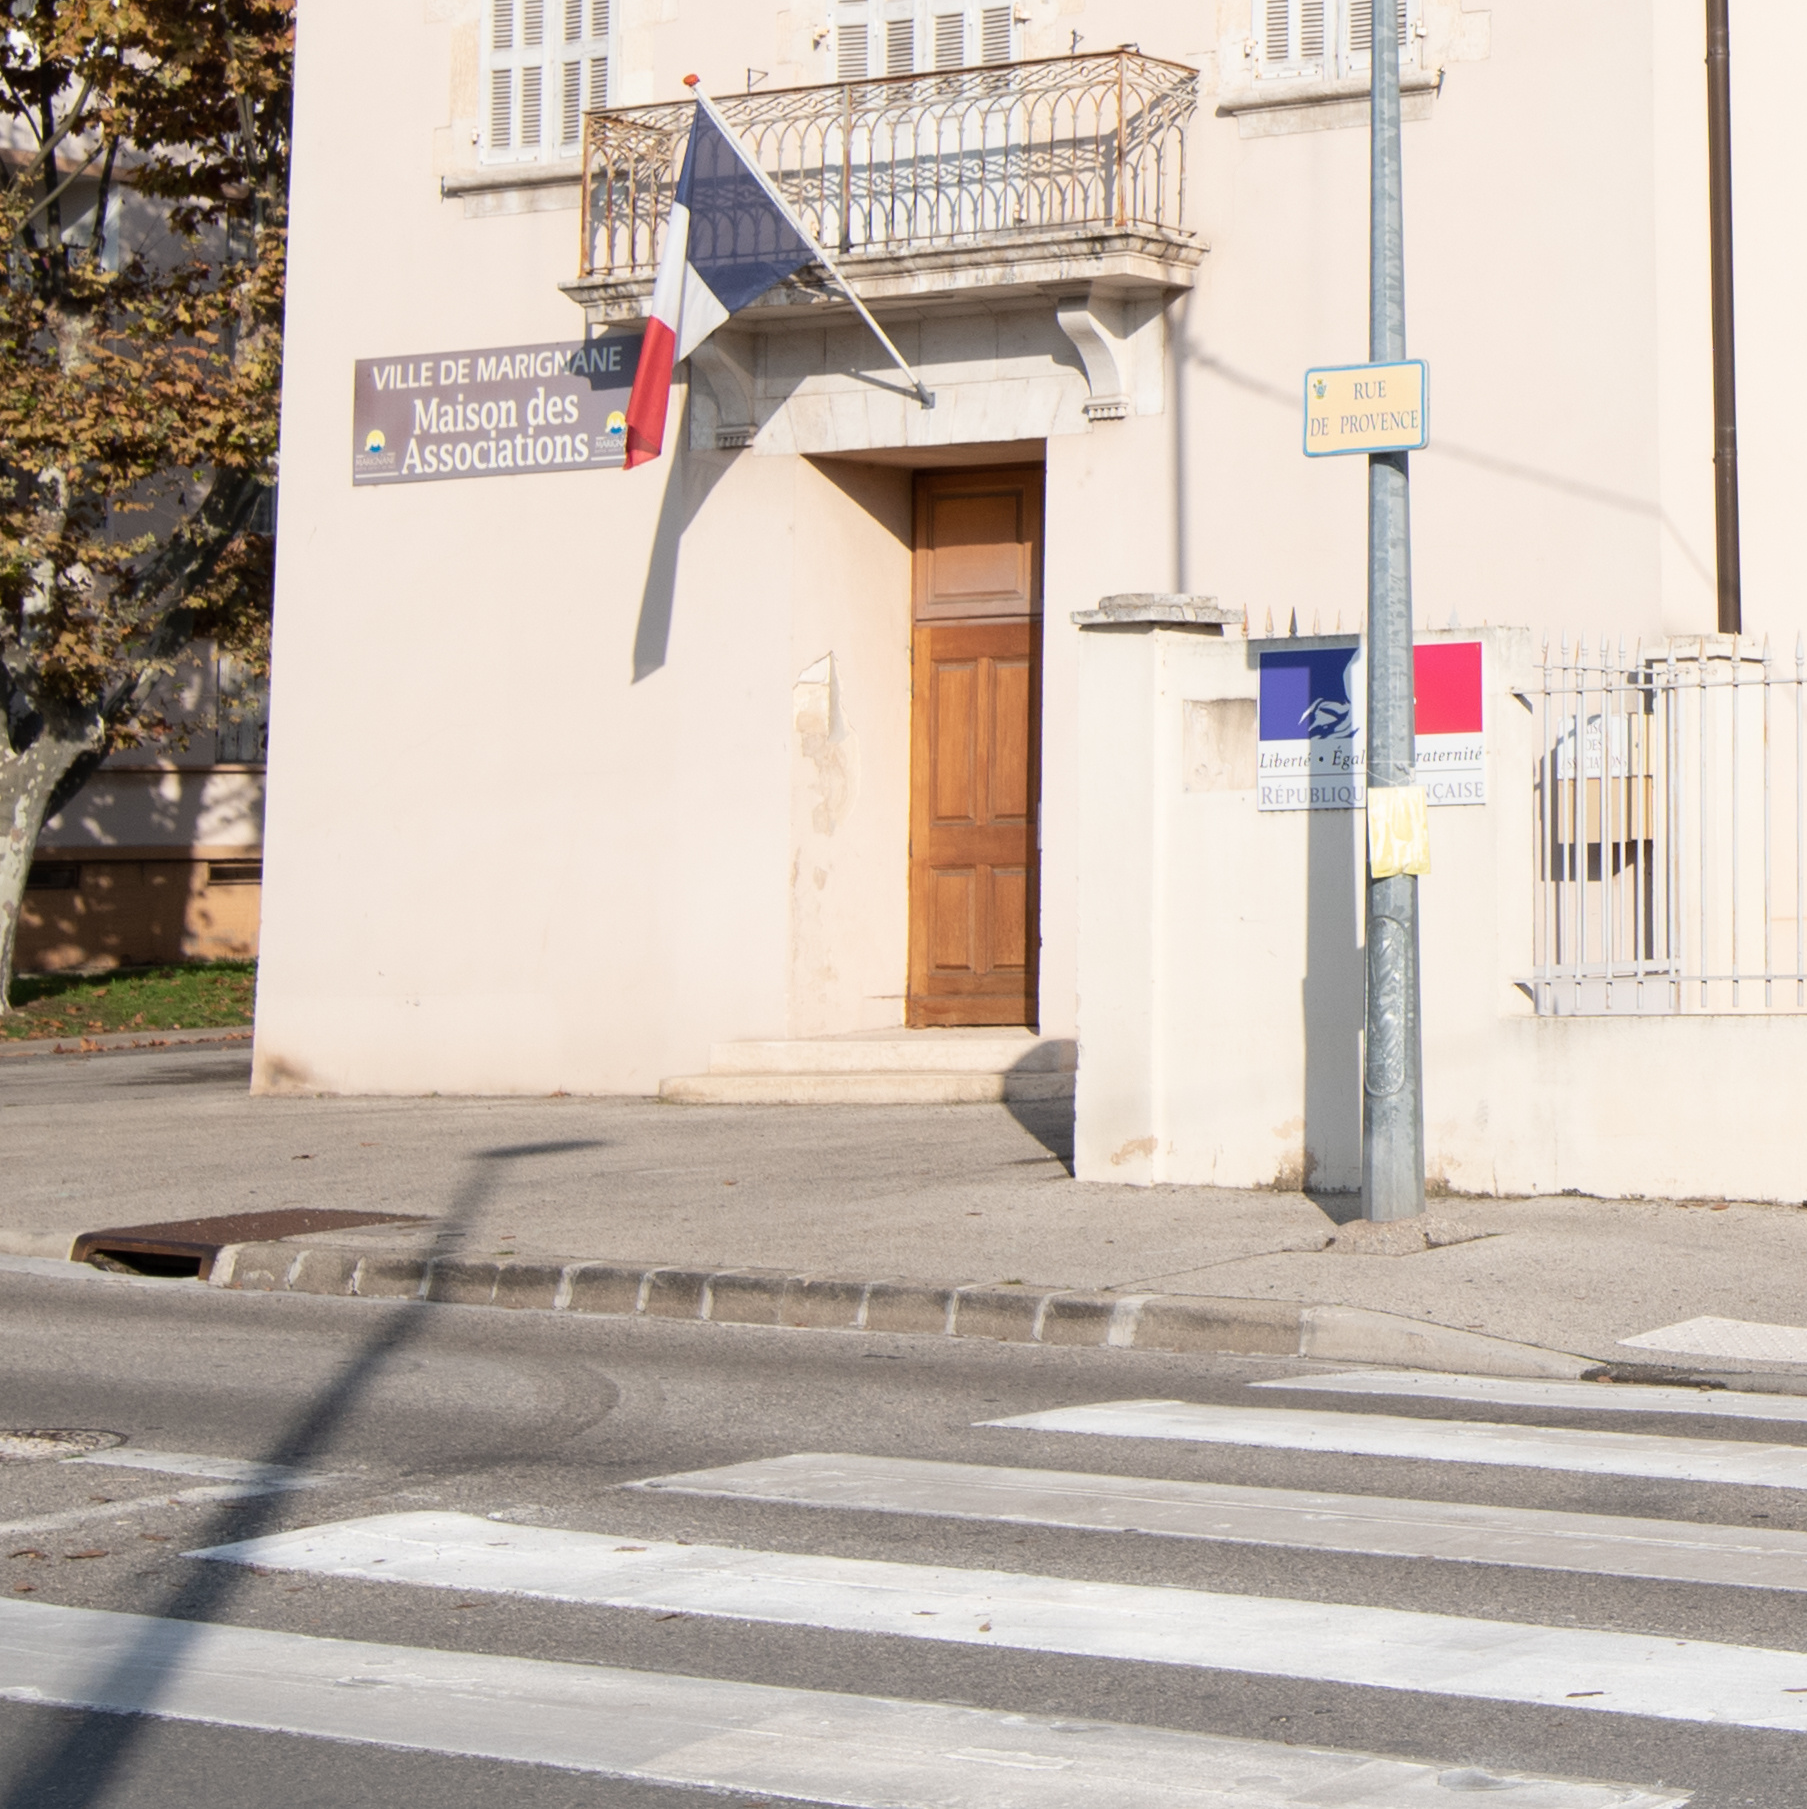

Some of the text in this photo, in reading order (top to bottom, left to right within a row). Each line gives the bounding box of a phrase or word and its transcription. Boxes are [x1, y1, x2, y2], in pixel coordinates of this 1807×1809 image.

[372, 346, 622, 391] VILLE DE MARIGNANE
[1354, 380, 1387, 400] RUE
[413, 387, 579, 436] Maison des
[1310, 410, 1419, 437] DE PROVENCE
[401, 426, 590, 475] Associations
[1260, 745, 1482, 770] Liberté Égal raternité
[1261, 781, 1484, 805] RÉPUBLIQU ÇAISE
